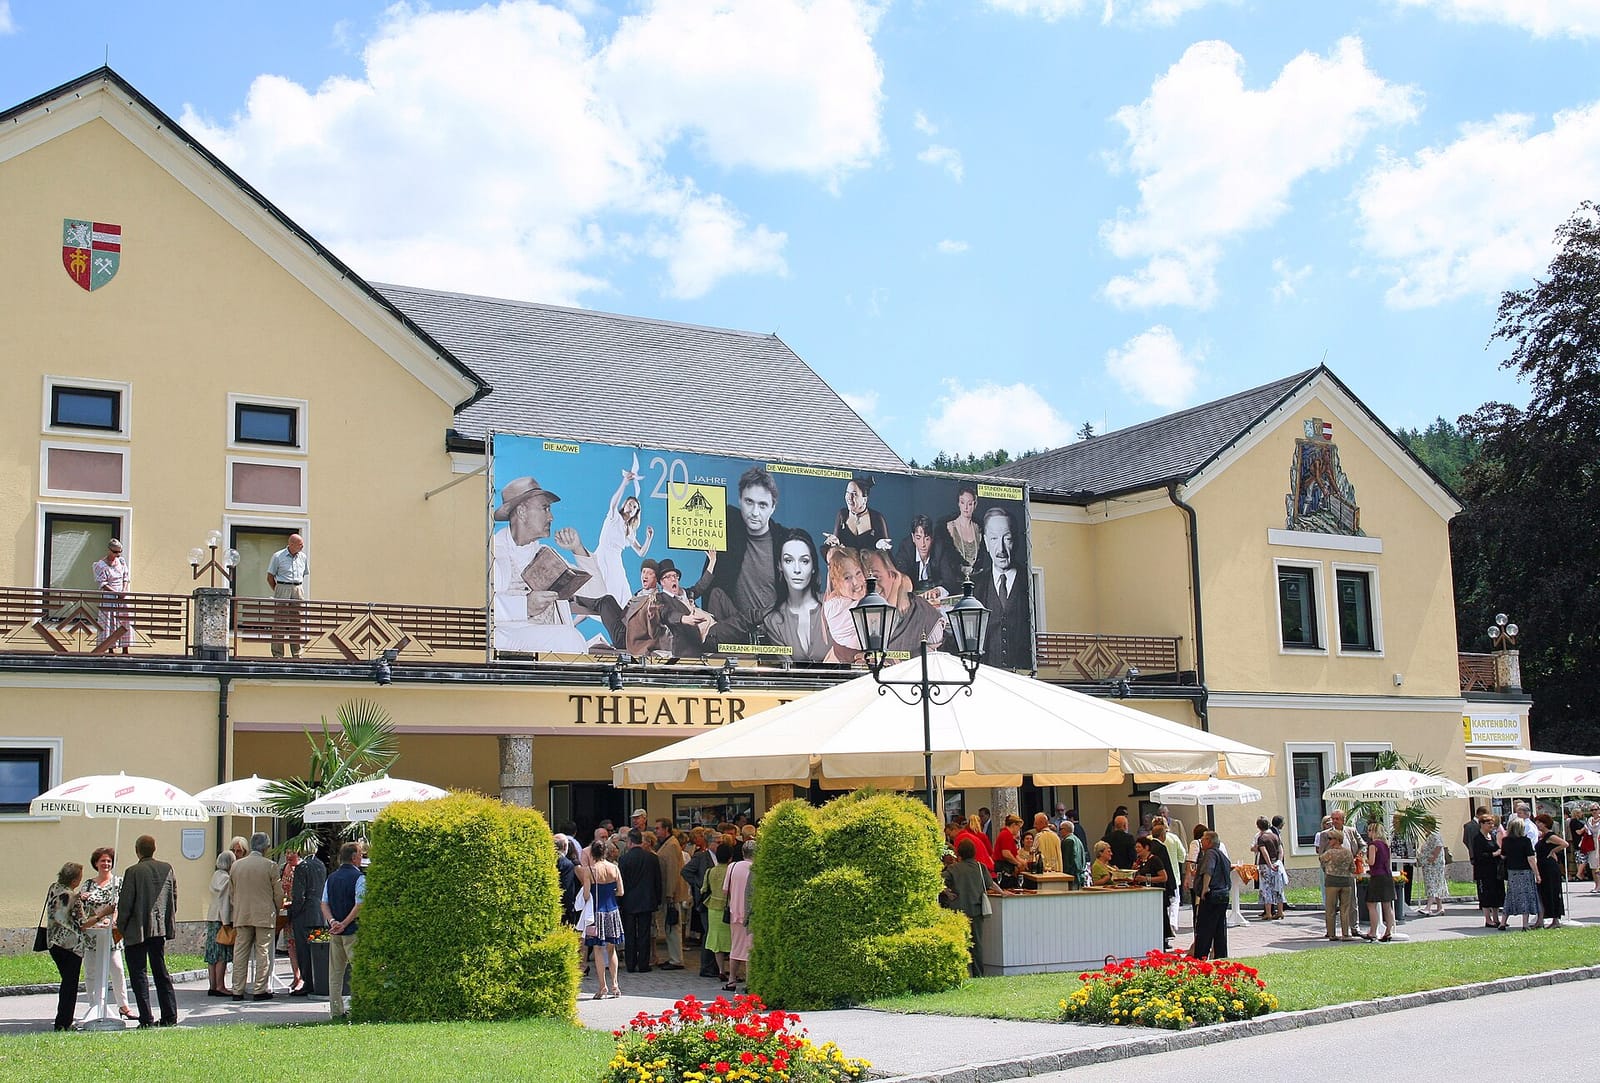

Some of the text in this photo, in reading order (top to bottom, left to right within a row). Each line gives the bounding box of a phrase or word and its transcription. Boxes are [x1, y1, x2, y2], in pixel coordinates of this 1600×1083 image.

[544, 443, 554, 451] DIE
[649, 456, 728, 501] 20 JAHRE
[671, 516, 724, 529] FESTSPIELE
[671, 526, 724, 539] REICHENAU
[686, 537, 709, 548] 2008
[568, 694, 746, 726] THEATER
[1472, 718, 1518, 729] KARTENBÜRO
[1473, 732, 1519, 742] THEATERSHOP
[1330, 791, 1355, 799] HENKELL
[41, 802, 80, 812] HENKELL
[95, 804, 152, 815] HENKELL
[162, 807, 200, 817] HENKELL
[206, 805, 226, 813] NKELL
[237, 806, 280, 814] HENKE
